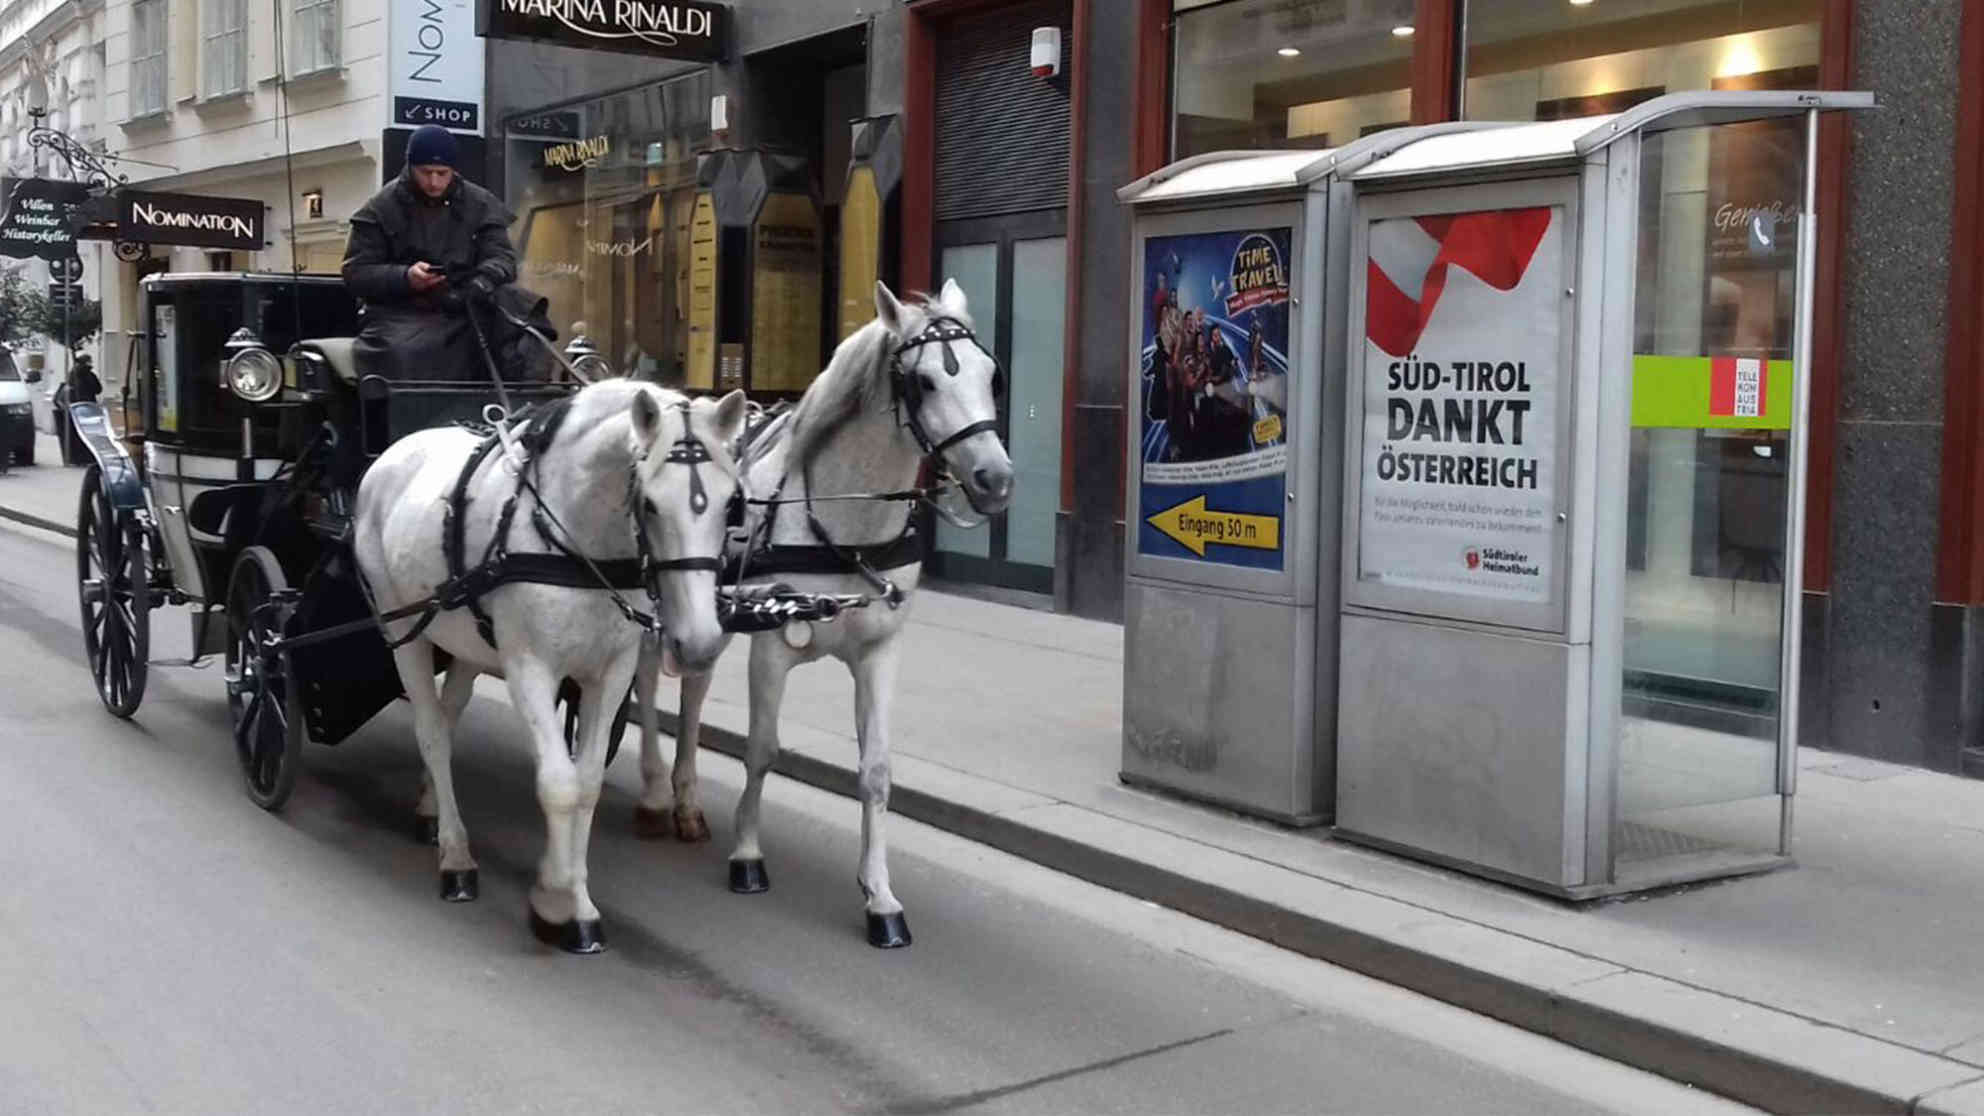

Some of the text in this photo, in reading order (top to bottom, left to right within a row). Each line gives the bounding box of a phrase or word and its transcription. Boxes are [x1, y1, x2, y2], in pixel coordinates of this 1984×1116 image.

[615, 1, 712, 42] RINALDI
[424, 106, 471, 122] SHOP
[132, 202, 254, 239] NOMINATION
[1231, 264, 1288, 290] TRAVEL
[1388, 355, 1531, 392] SÜD-TIROL
[1387, 398, 1531, 445] DANKT
[1377, 445, 1538, 489] ÖSTERREICH
[1178, 513, 1257, 539] Eingang 50 m
[1483, 549, 1528, 563] Südtiroler
[1483, 562, 1539, 577] Heimatbund
